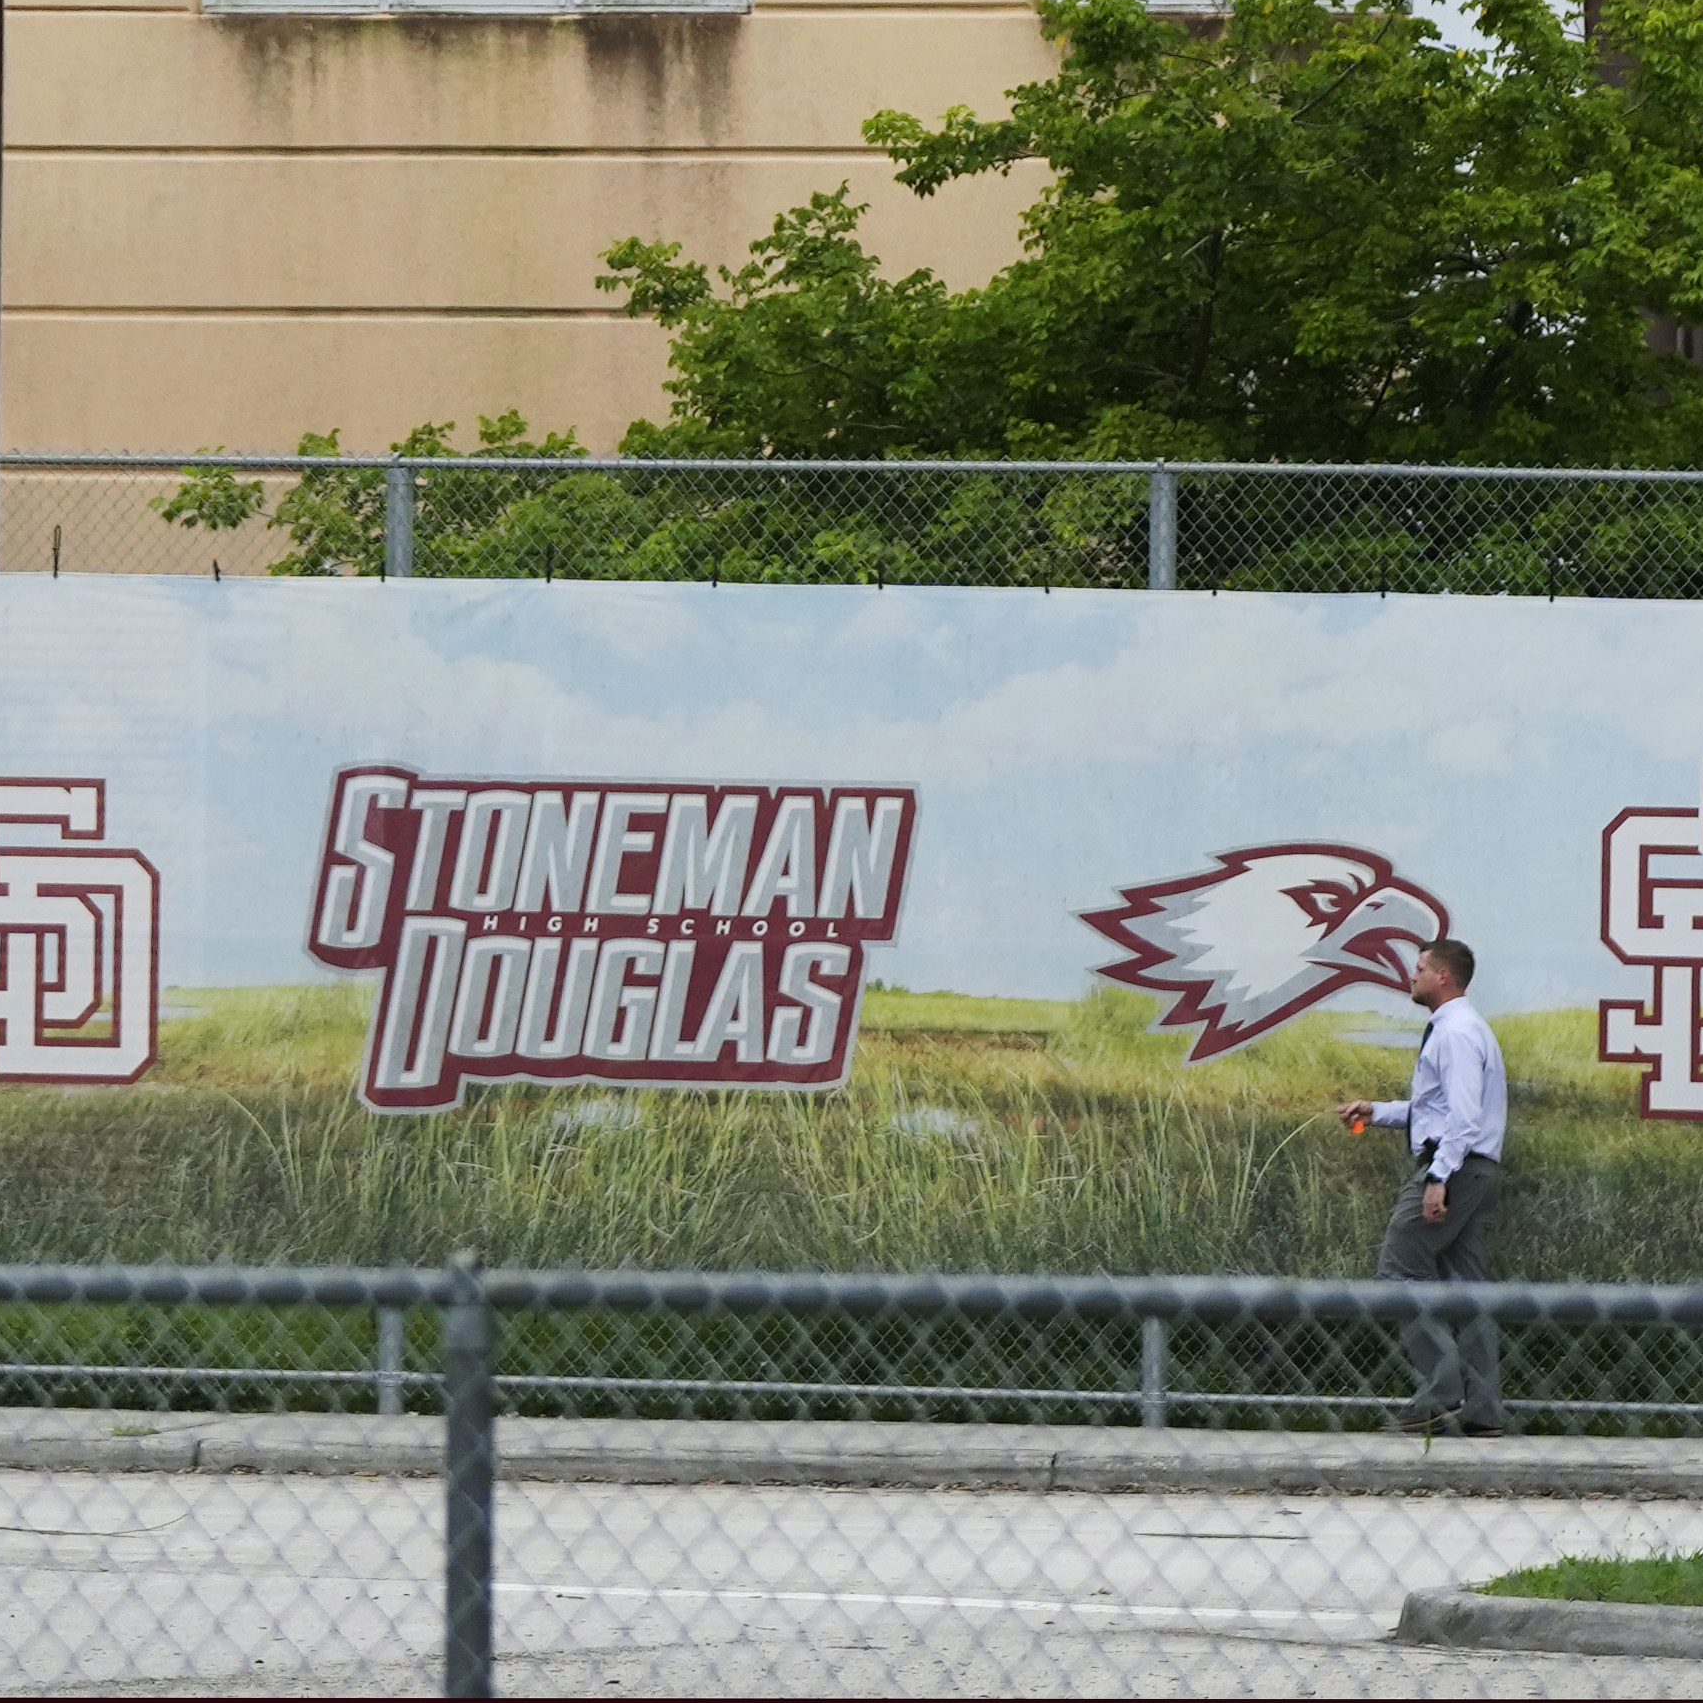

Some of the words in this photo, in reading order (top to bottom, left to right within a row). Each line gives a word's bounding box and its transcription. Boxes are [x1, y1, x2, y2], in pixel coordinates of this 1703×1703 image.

[317, 773, 905, 950] STONEMAN
[482, 914, 600, 933] HIGH
[646, 916, 841, 938] SCHOOL
[373, 915, 852, 1090] DOUGLAS
